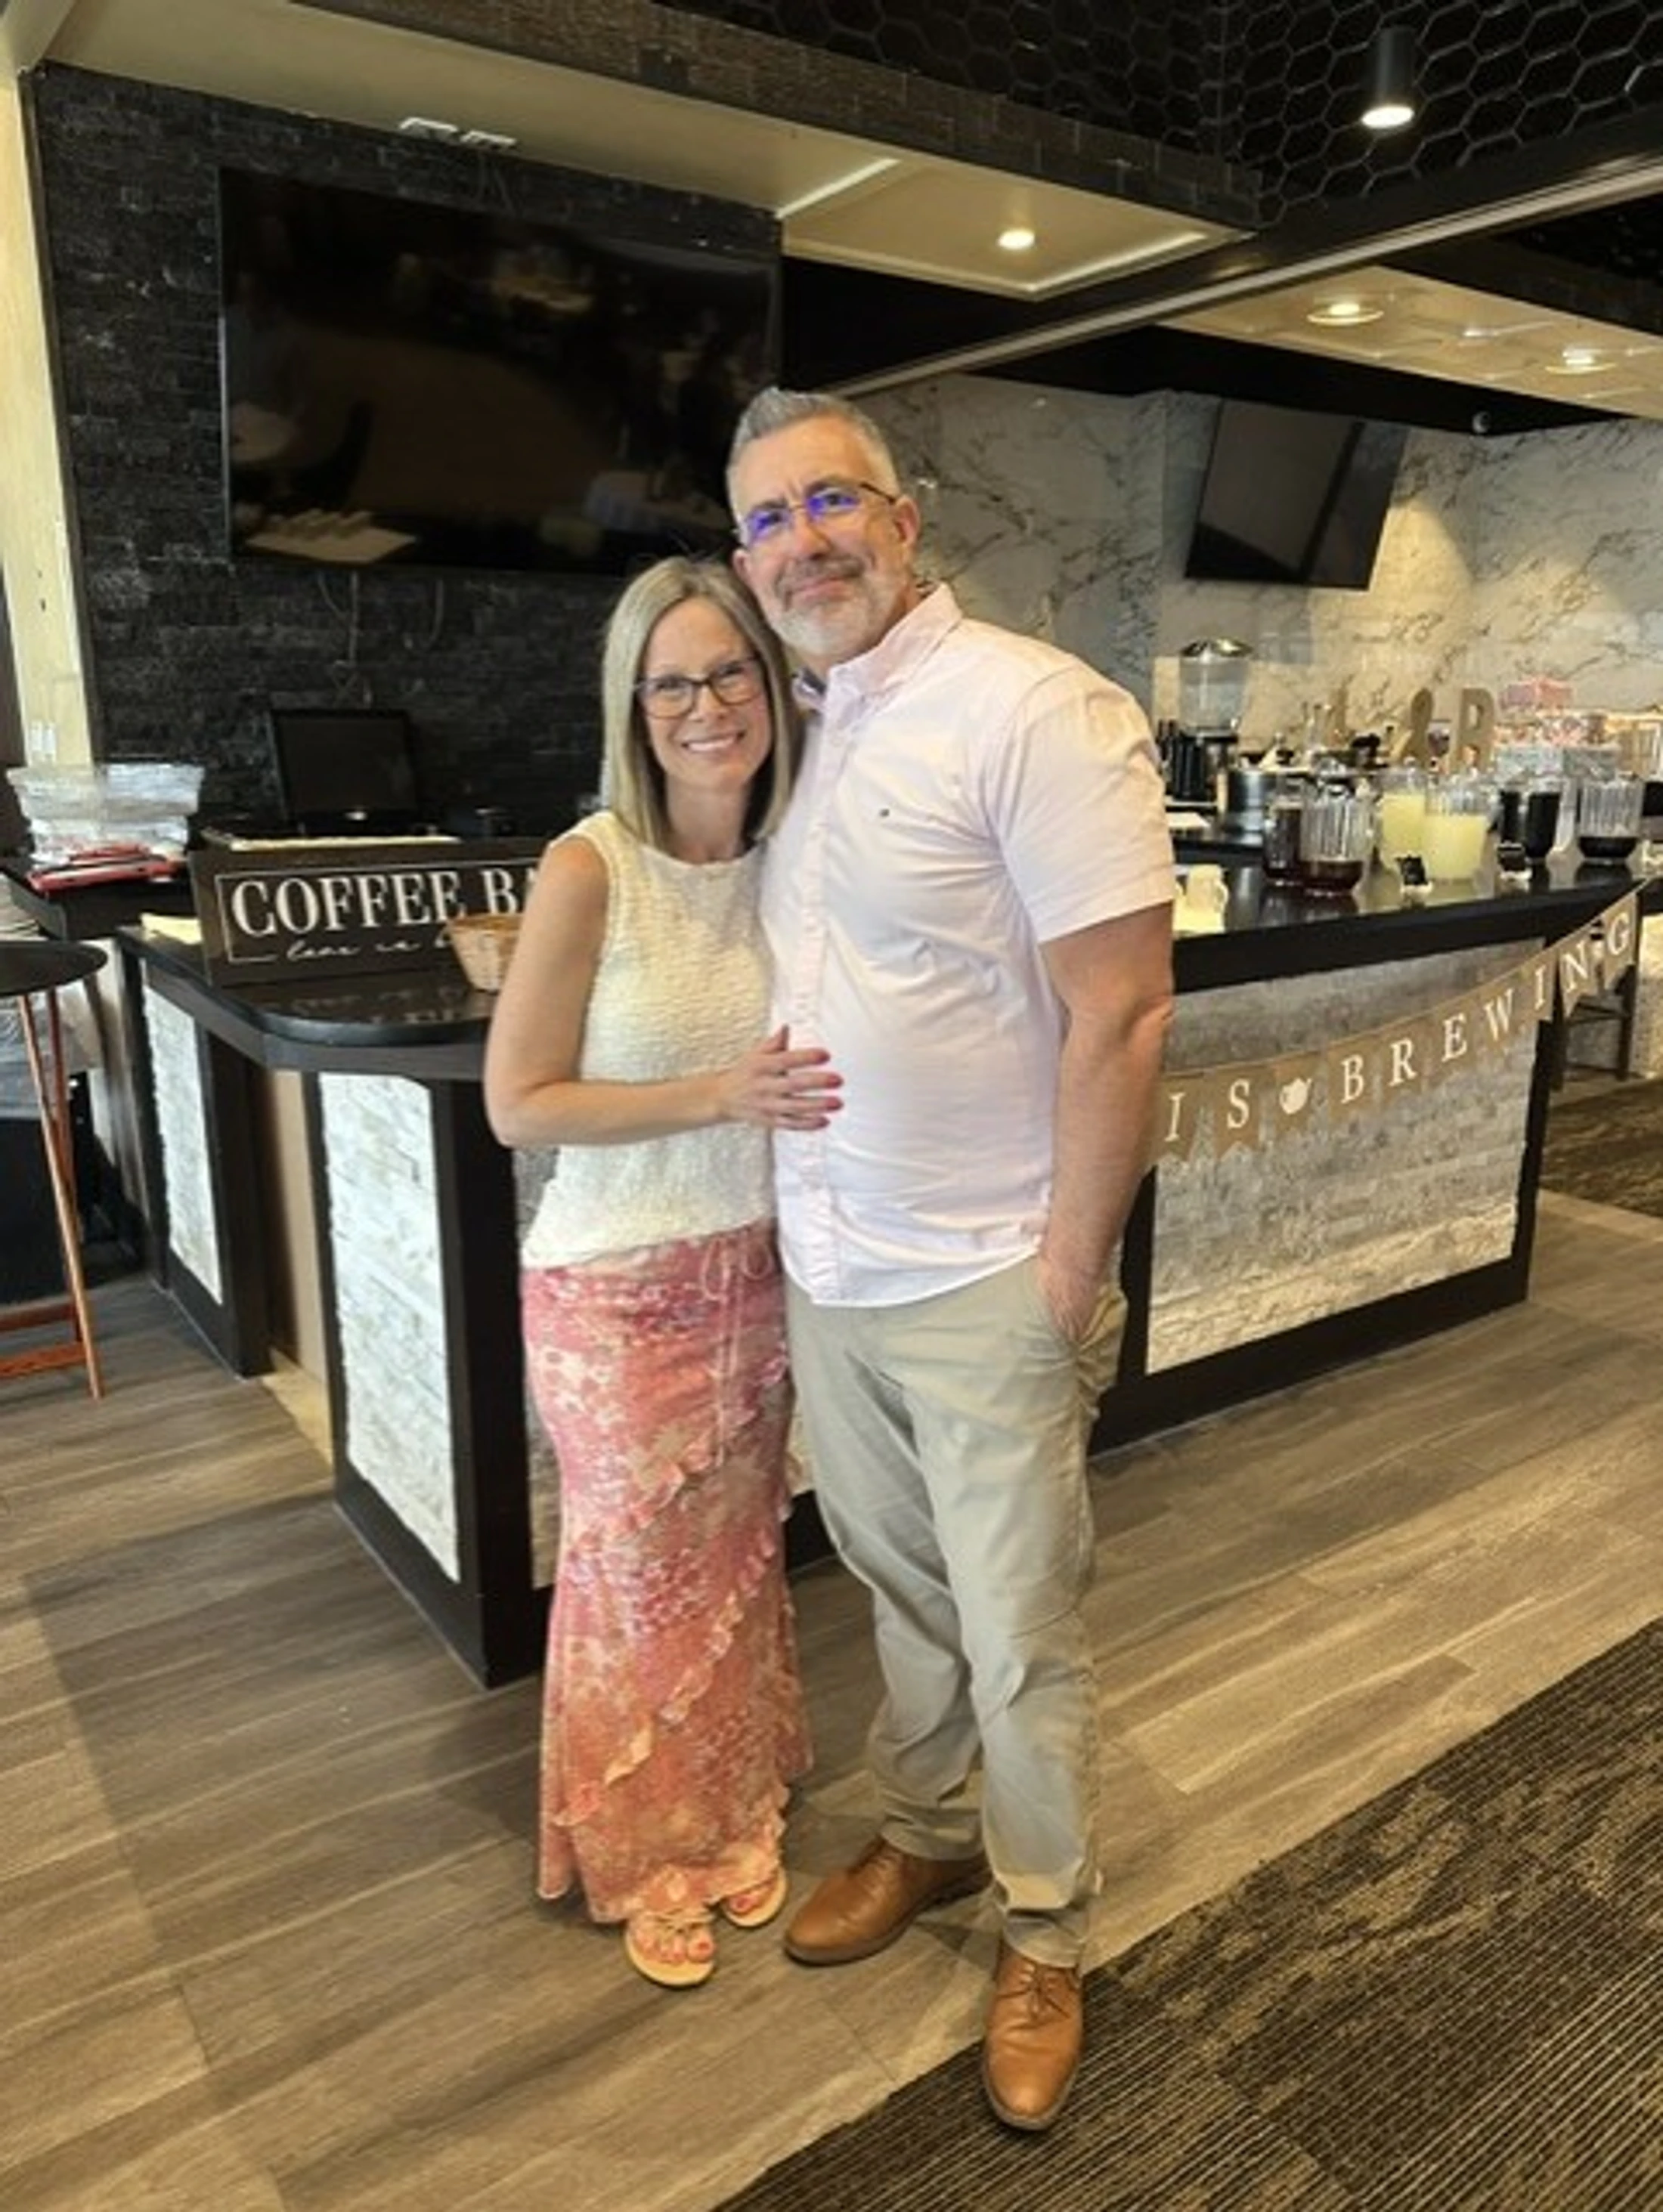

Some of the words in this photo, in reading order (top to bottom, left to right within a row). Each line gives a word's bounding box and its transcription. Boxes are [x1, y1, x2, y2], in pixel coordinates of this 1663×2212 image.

[231, 870, 466, 937] COFFEE
[1165, 1078, 1252, 1142] IS
[1340, 911, 1631, 1105] BREWING
